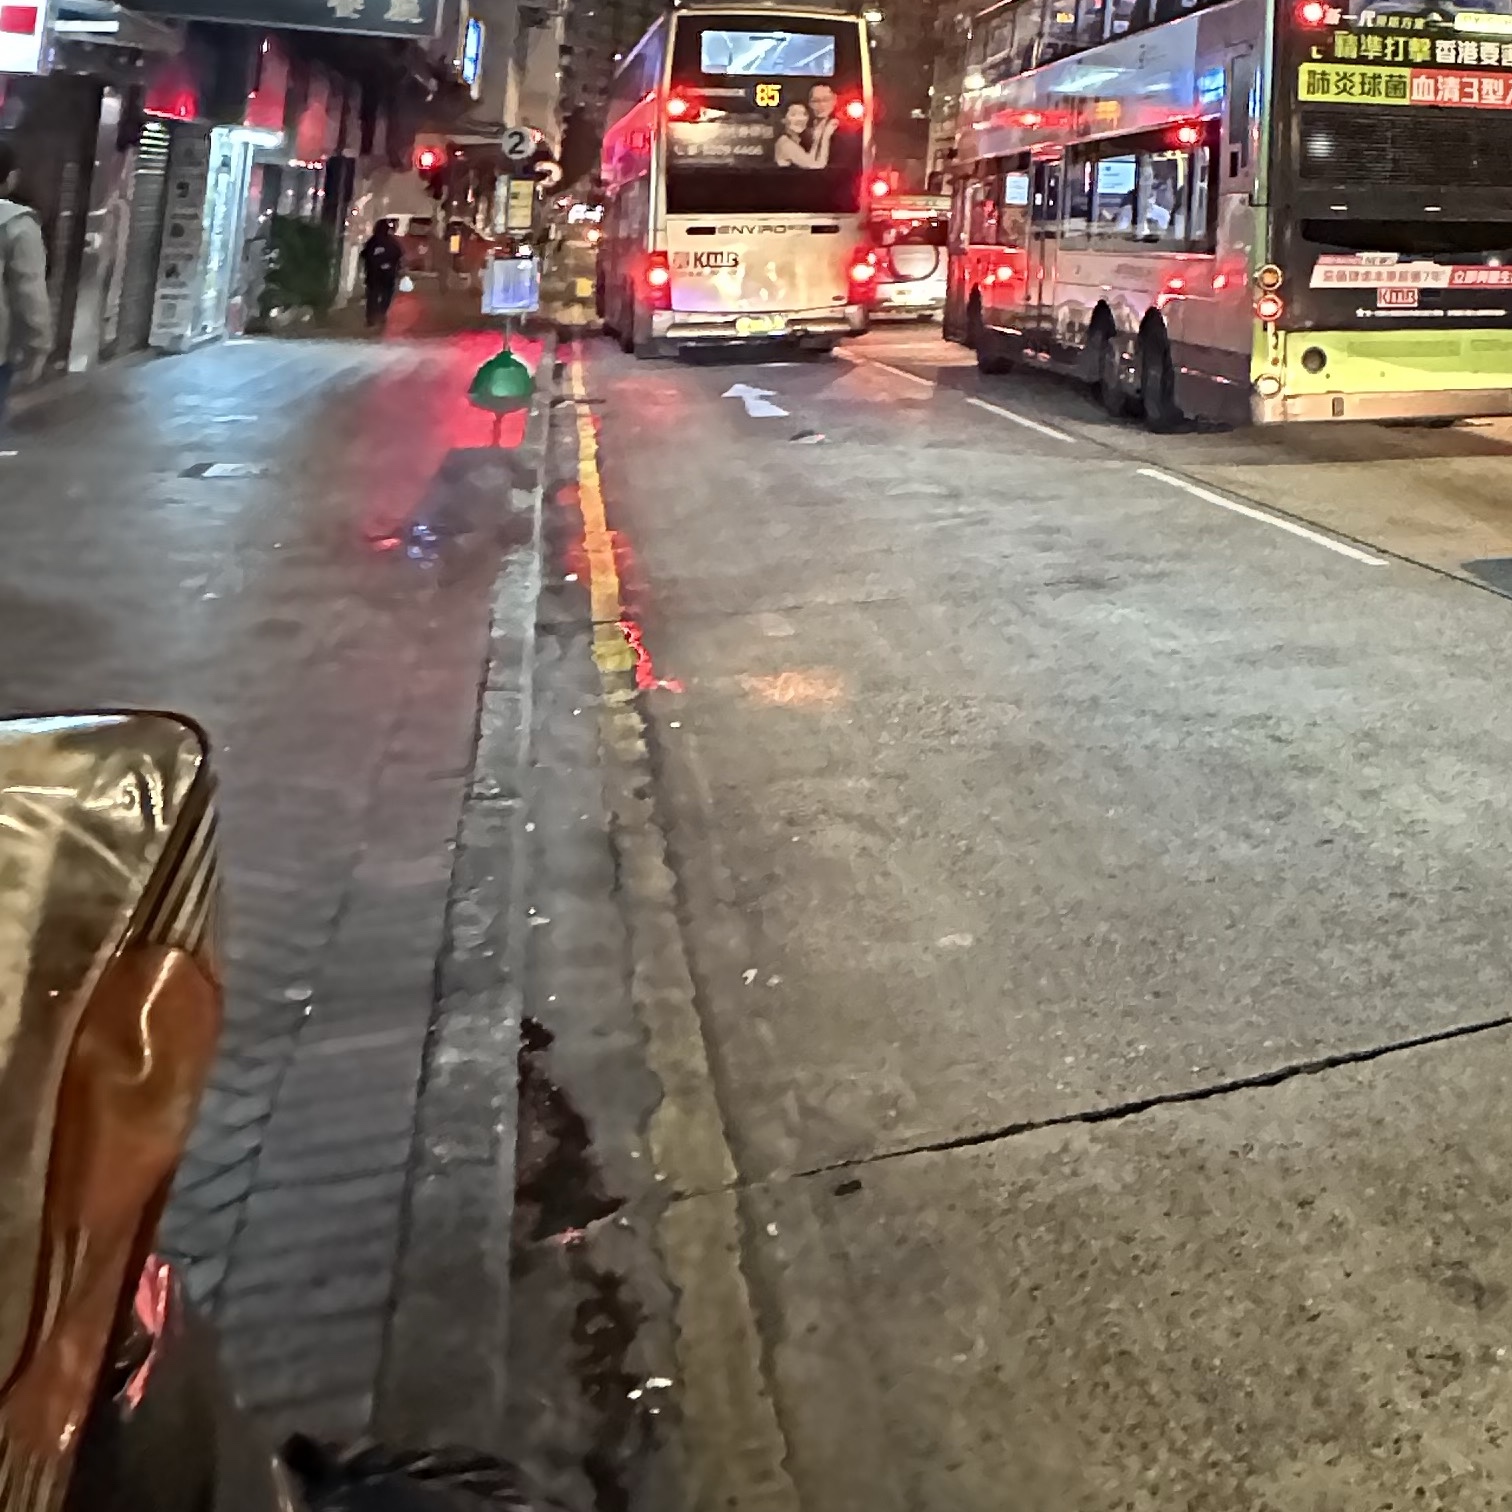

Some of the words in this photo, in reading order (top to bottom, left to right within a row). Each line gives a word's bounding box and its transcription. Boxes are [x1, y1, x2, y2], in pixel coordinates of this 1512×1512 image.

[755, 83, 782, 106] 85
[1307, 68, 1408, 99] 肺炎球菌
[508, 131, 525, 154] 2
